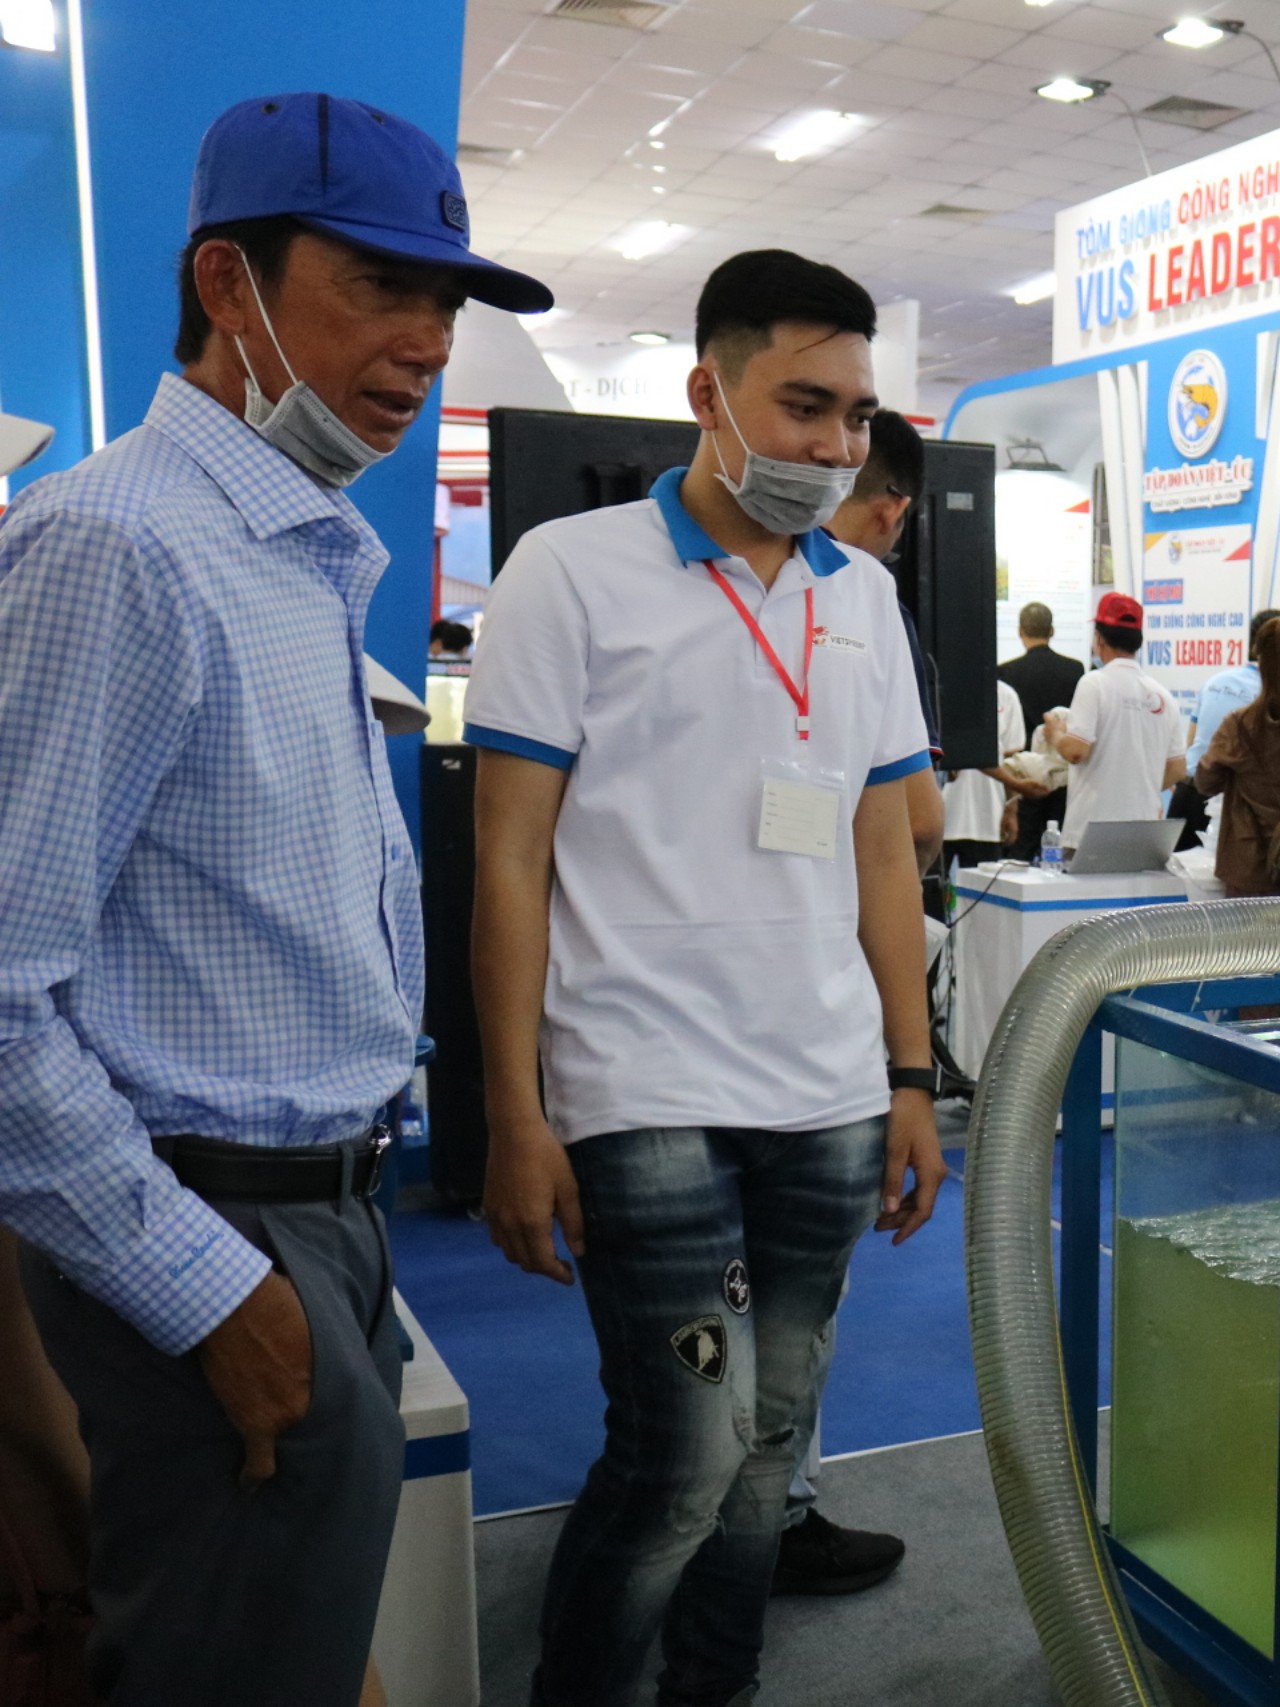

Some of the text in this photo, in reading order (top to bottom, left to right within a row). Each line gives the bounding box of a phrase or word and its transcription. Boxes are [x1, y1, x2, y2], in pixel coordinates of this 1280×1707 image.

[1076, 259, 1134, 331] VUS
[1148, 639, 1242, 665] VUS LEADER 21
